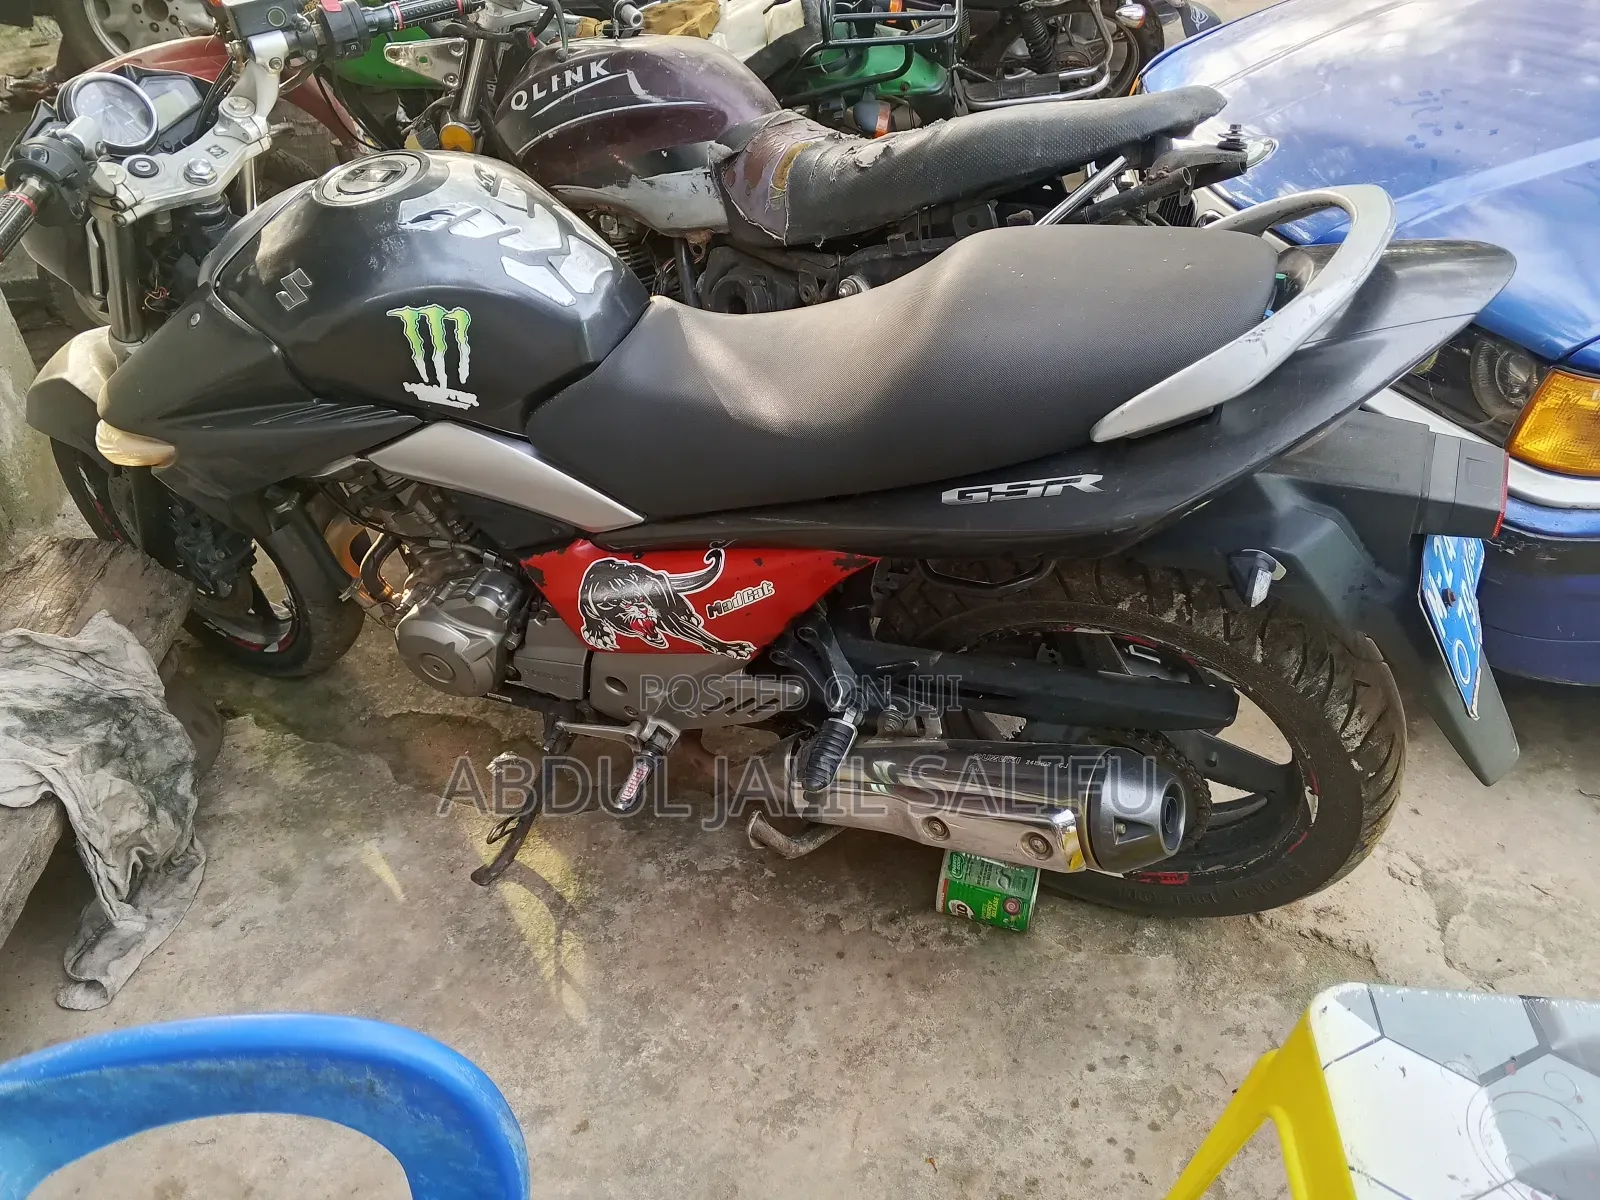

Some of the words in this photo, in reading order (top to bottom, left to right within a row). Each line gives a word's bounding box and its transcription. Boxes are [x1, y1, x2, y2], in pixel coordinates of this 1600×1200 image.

[511, 58, 610, 111] QLINK
[942, 474, 1104, 505] GSR
[973, 753, 1022, 765] SUZUKI
